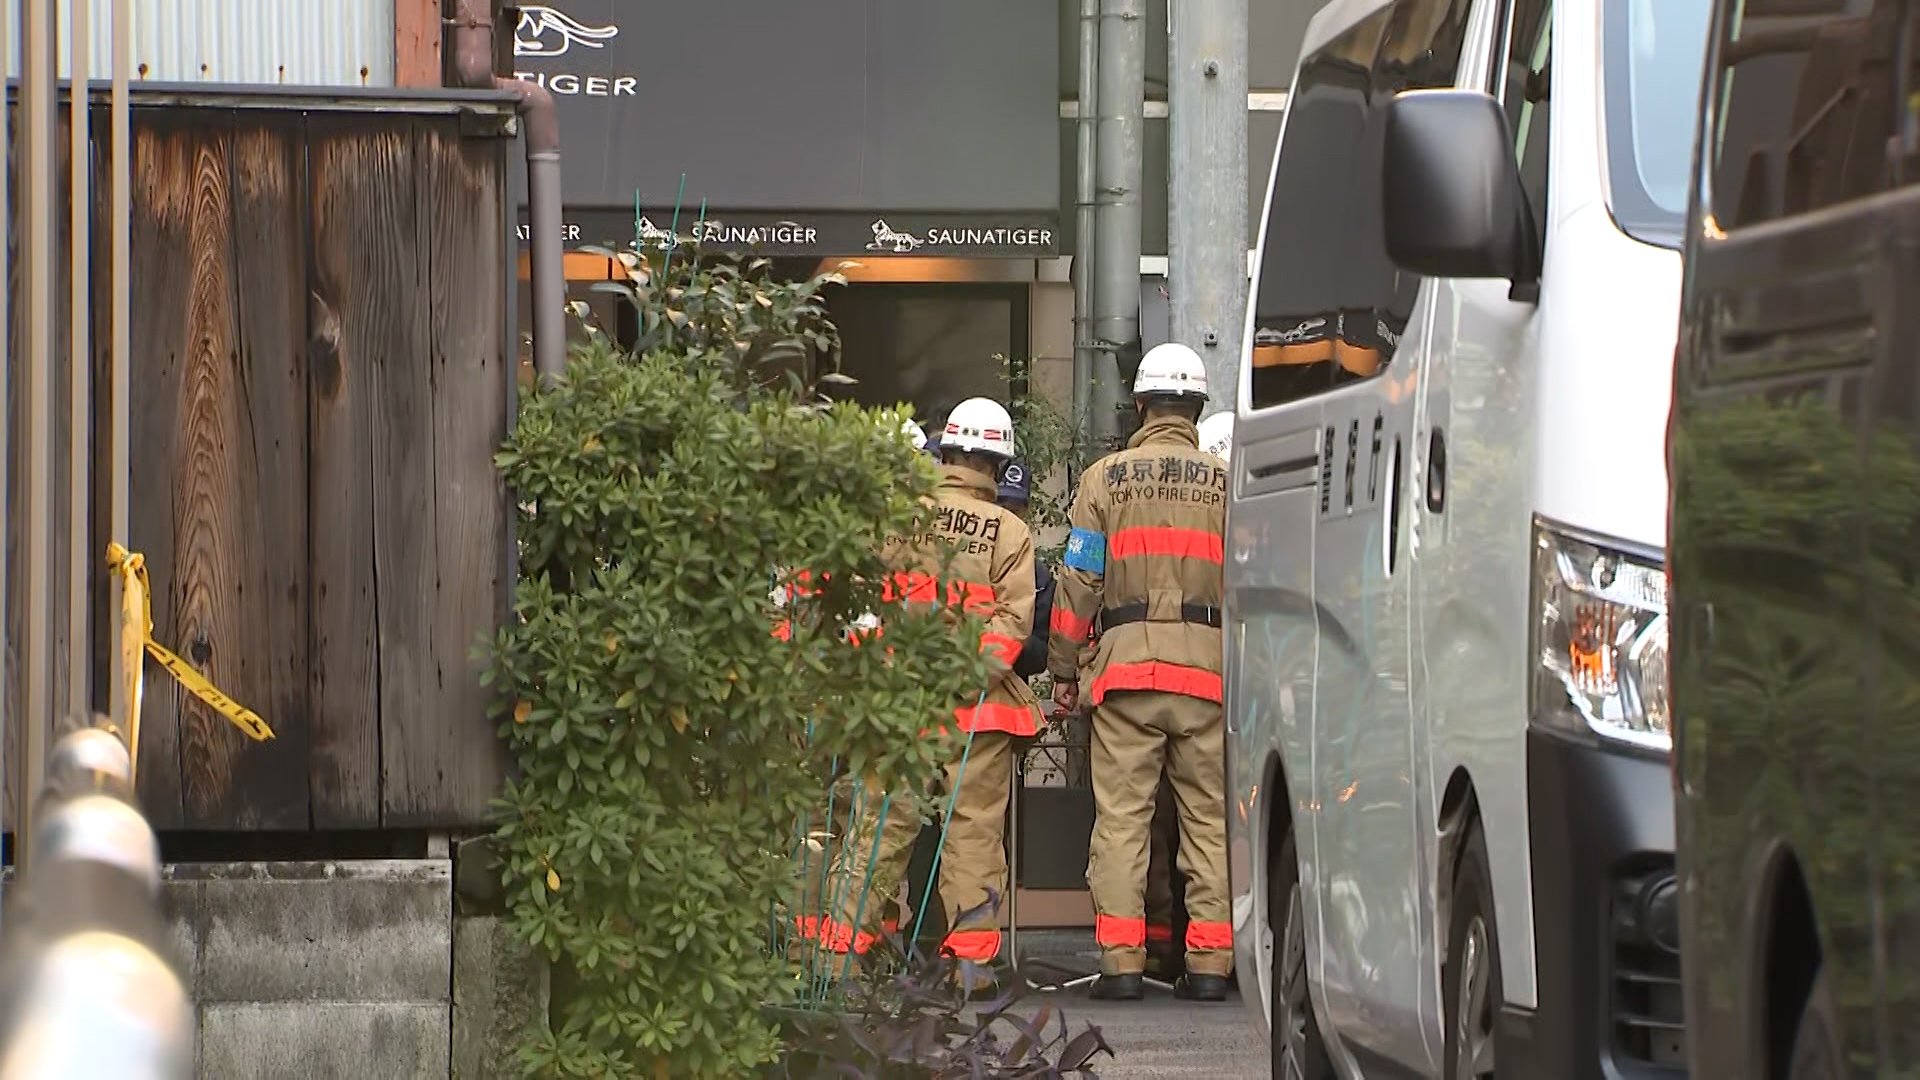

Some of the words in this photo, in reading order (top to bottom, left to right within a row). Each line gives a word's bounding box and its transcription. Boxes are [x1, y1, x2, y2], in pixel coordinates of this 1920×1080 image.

[692, 226, 817, 244] SAUNATIGER
[928, 228, 1052, 245] SAUNATIGER
[1105, 457, 1226, 491] 東京消防庁
[1109, 485, 1155, 506] TOKYO
[1158, 486, 1189, 502] FIRE
